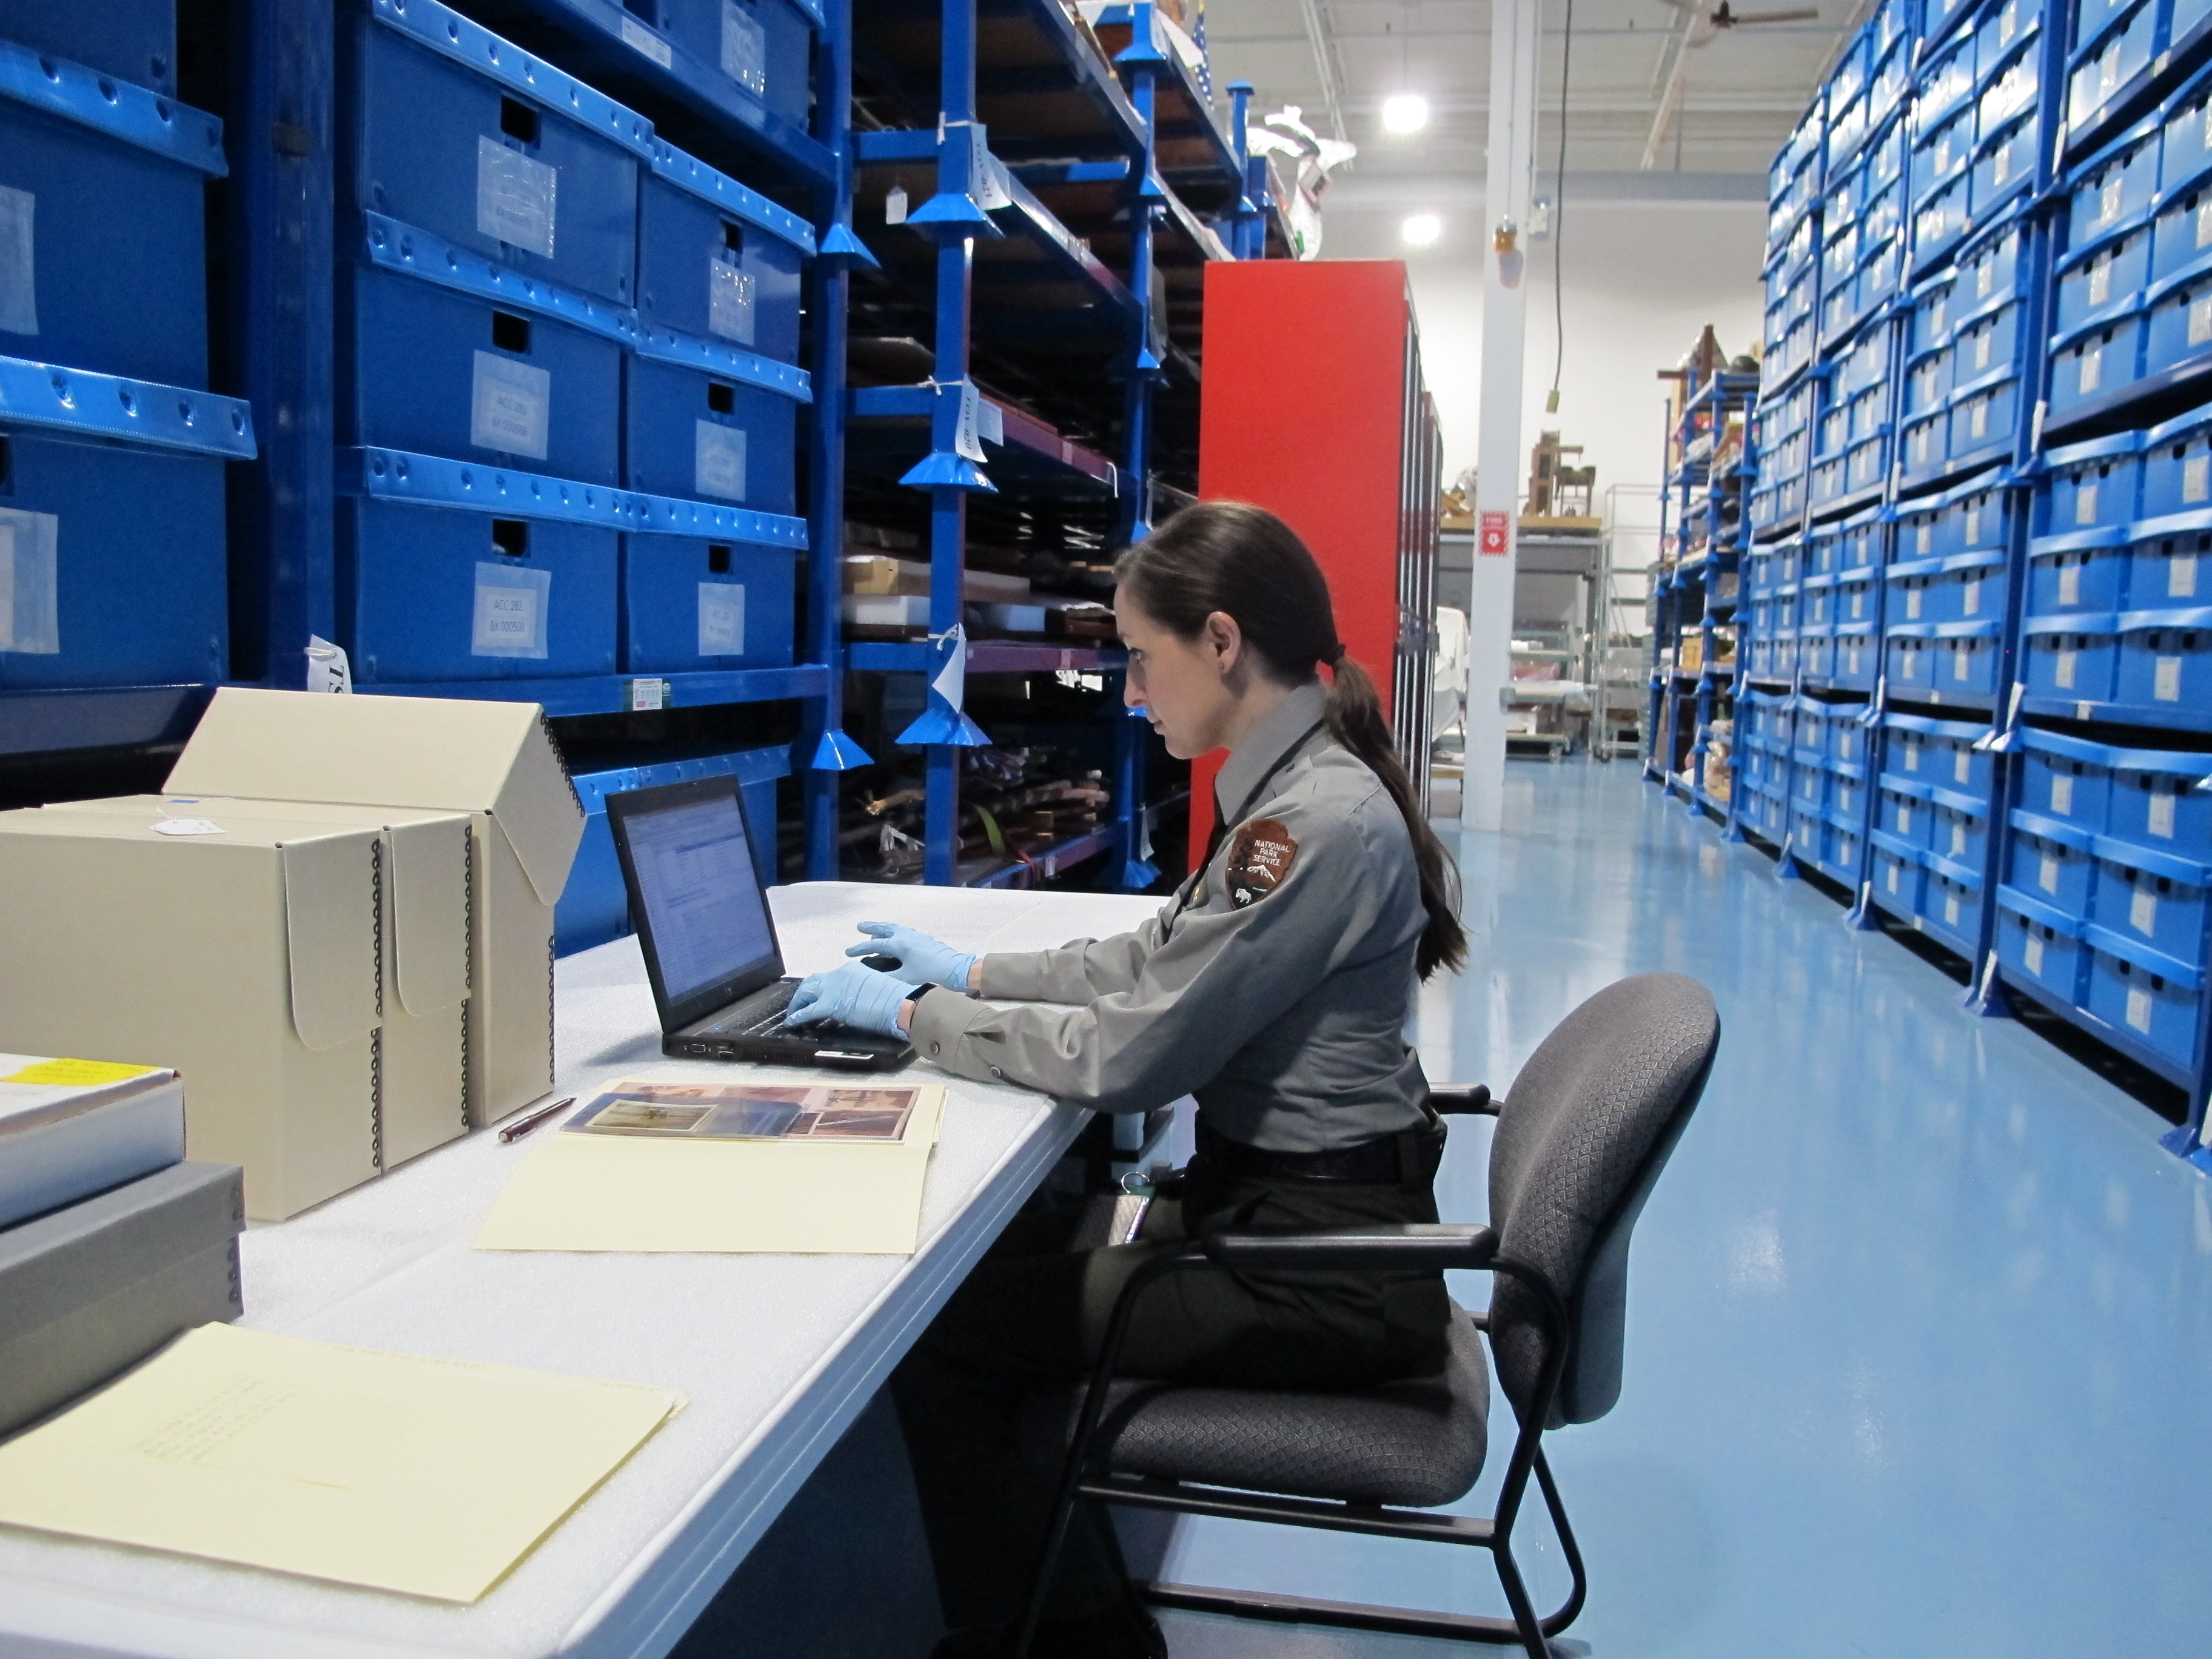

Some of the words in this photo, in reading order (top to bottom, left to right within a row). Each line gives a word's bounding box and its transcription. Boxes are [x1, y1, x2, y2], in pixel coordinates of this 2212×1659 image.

[494, 600, 509, 611] ACC
[1255, 840, 1290, 853] NATIONAL
[1259, 848, 1278, 858] PARK
[1252, 854, 1281, 866] SERVICE
